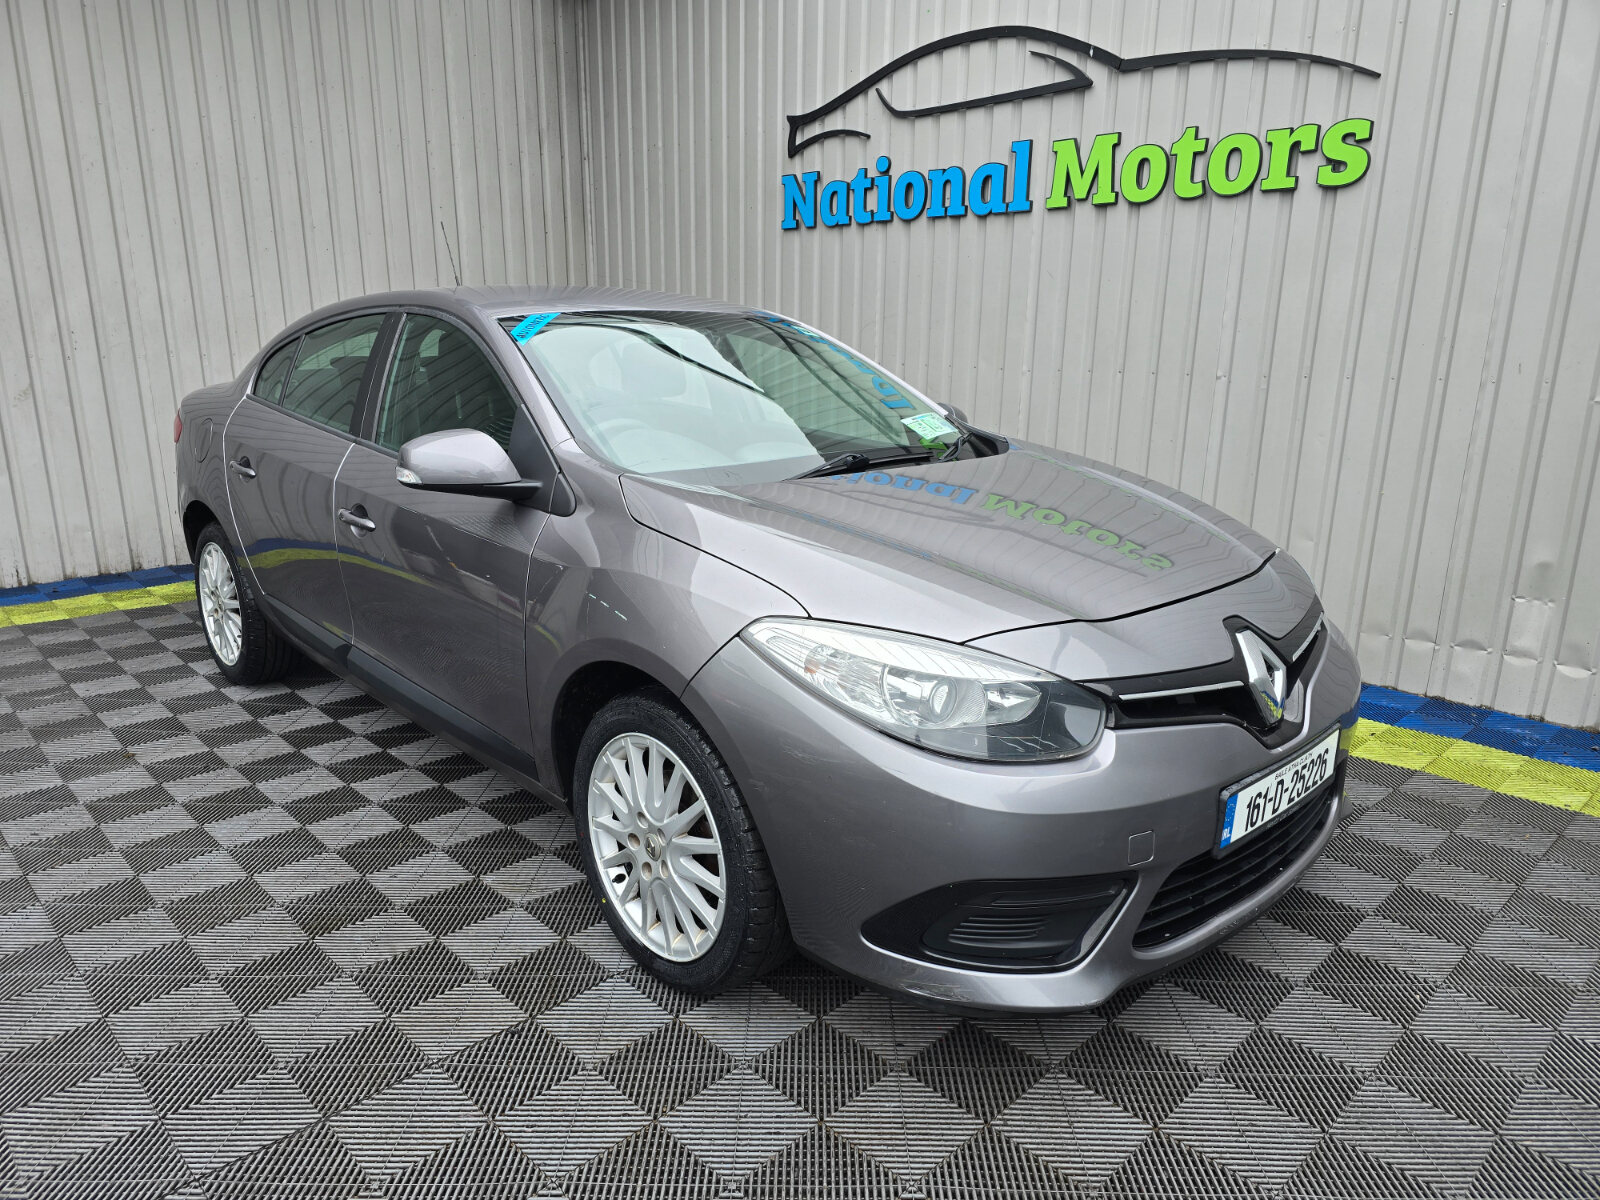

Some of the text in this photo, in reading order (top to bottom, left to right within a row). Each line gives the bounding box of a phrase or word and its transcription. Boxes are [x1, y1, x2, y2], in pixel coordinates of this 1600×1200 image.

[781, 117, 1375, 230] National Motors
[1245, 748, 1329, 832] 161-D-25226
[1221, 827, 1231, 841] IRL
